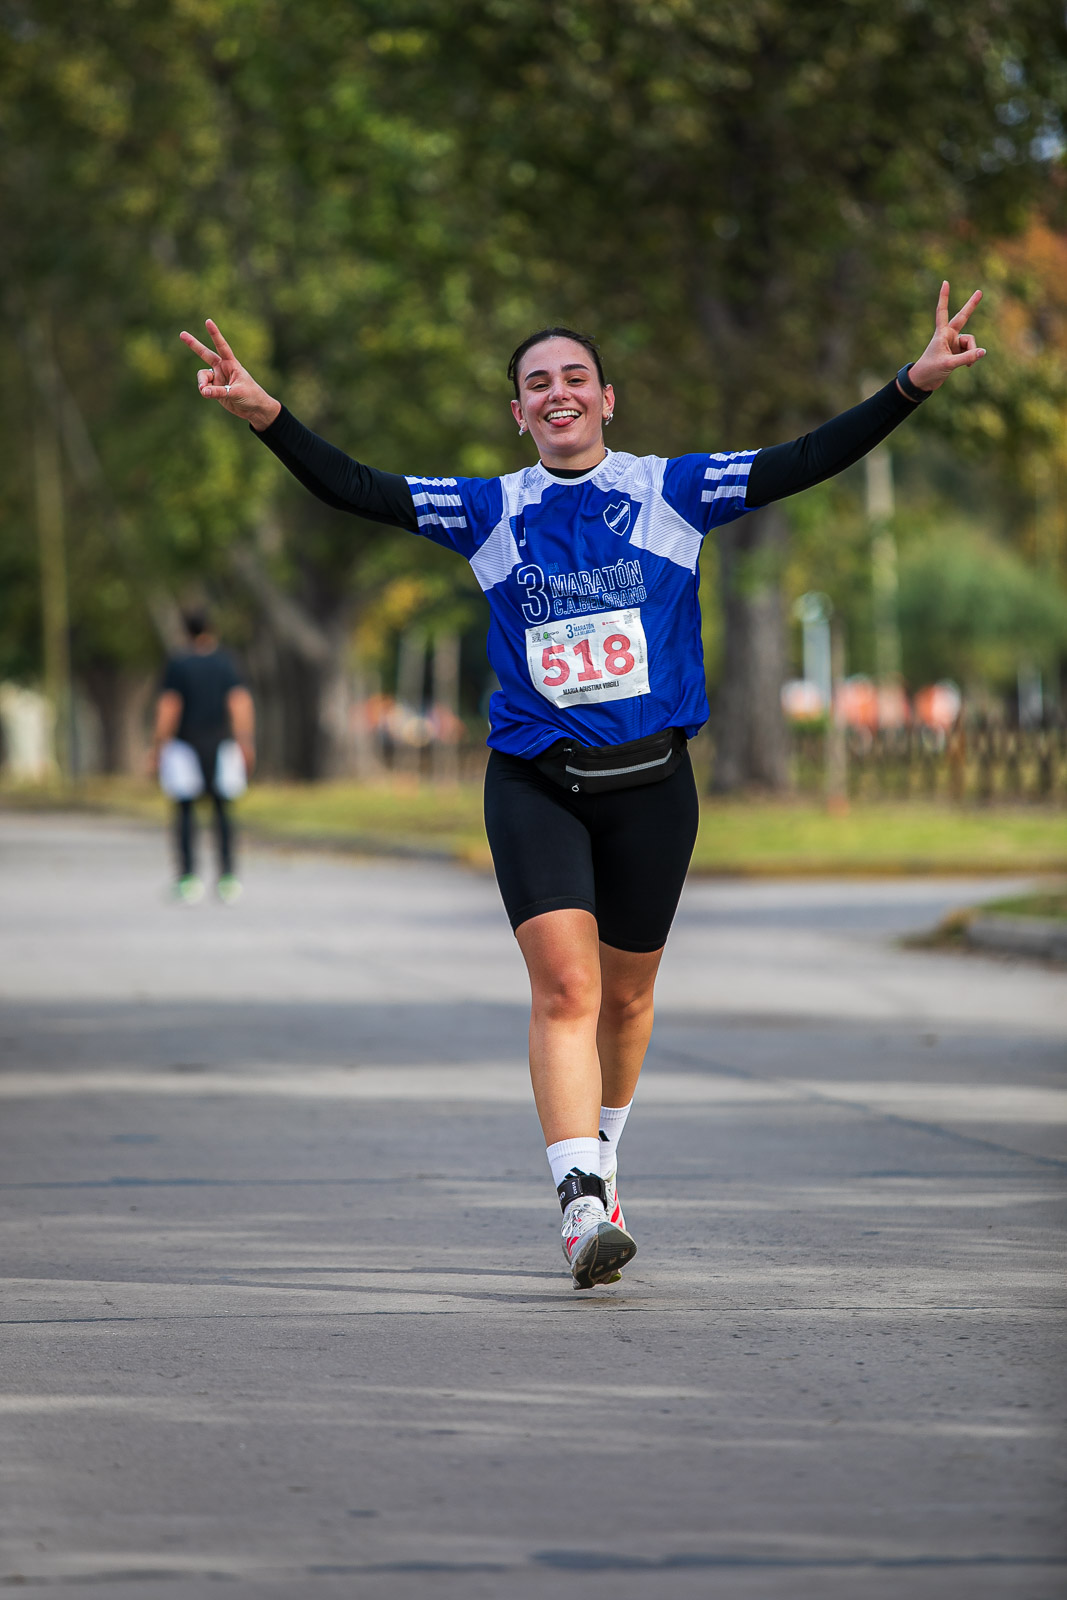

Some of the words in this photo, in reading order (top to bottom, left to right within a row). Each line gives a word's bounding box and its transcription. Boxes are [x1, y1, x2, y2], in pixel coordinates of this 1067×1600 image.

[516, 563, 551, 625] 3
[548, 558, 644, 599] MARATÓN
[553, 585, 648, 616] C.A.BELGRANO
[565, 623, 574, 639] 3
[573, 622, 596, 632] MARATÓN
[541, 633, 635, 687] 518
[562, 687, 579, 695] MARIA
[579, 683, 603, 693] AGUSTINA
